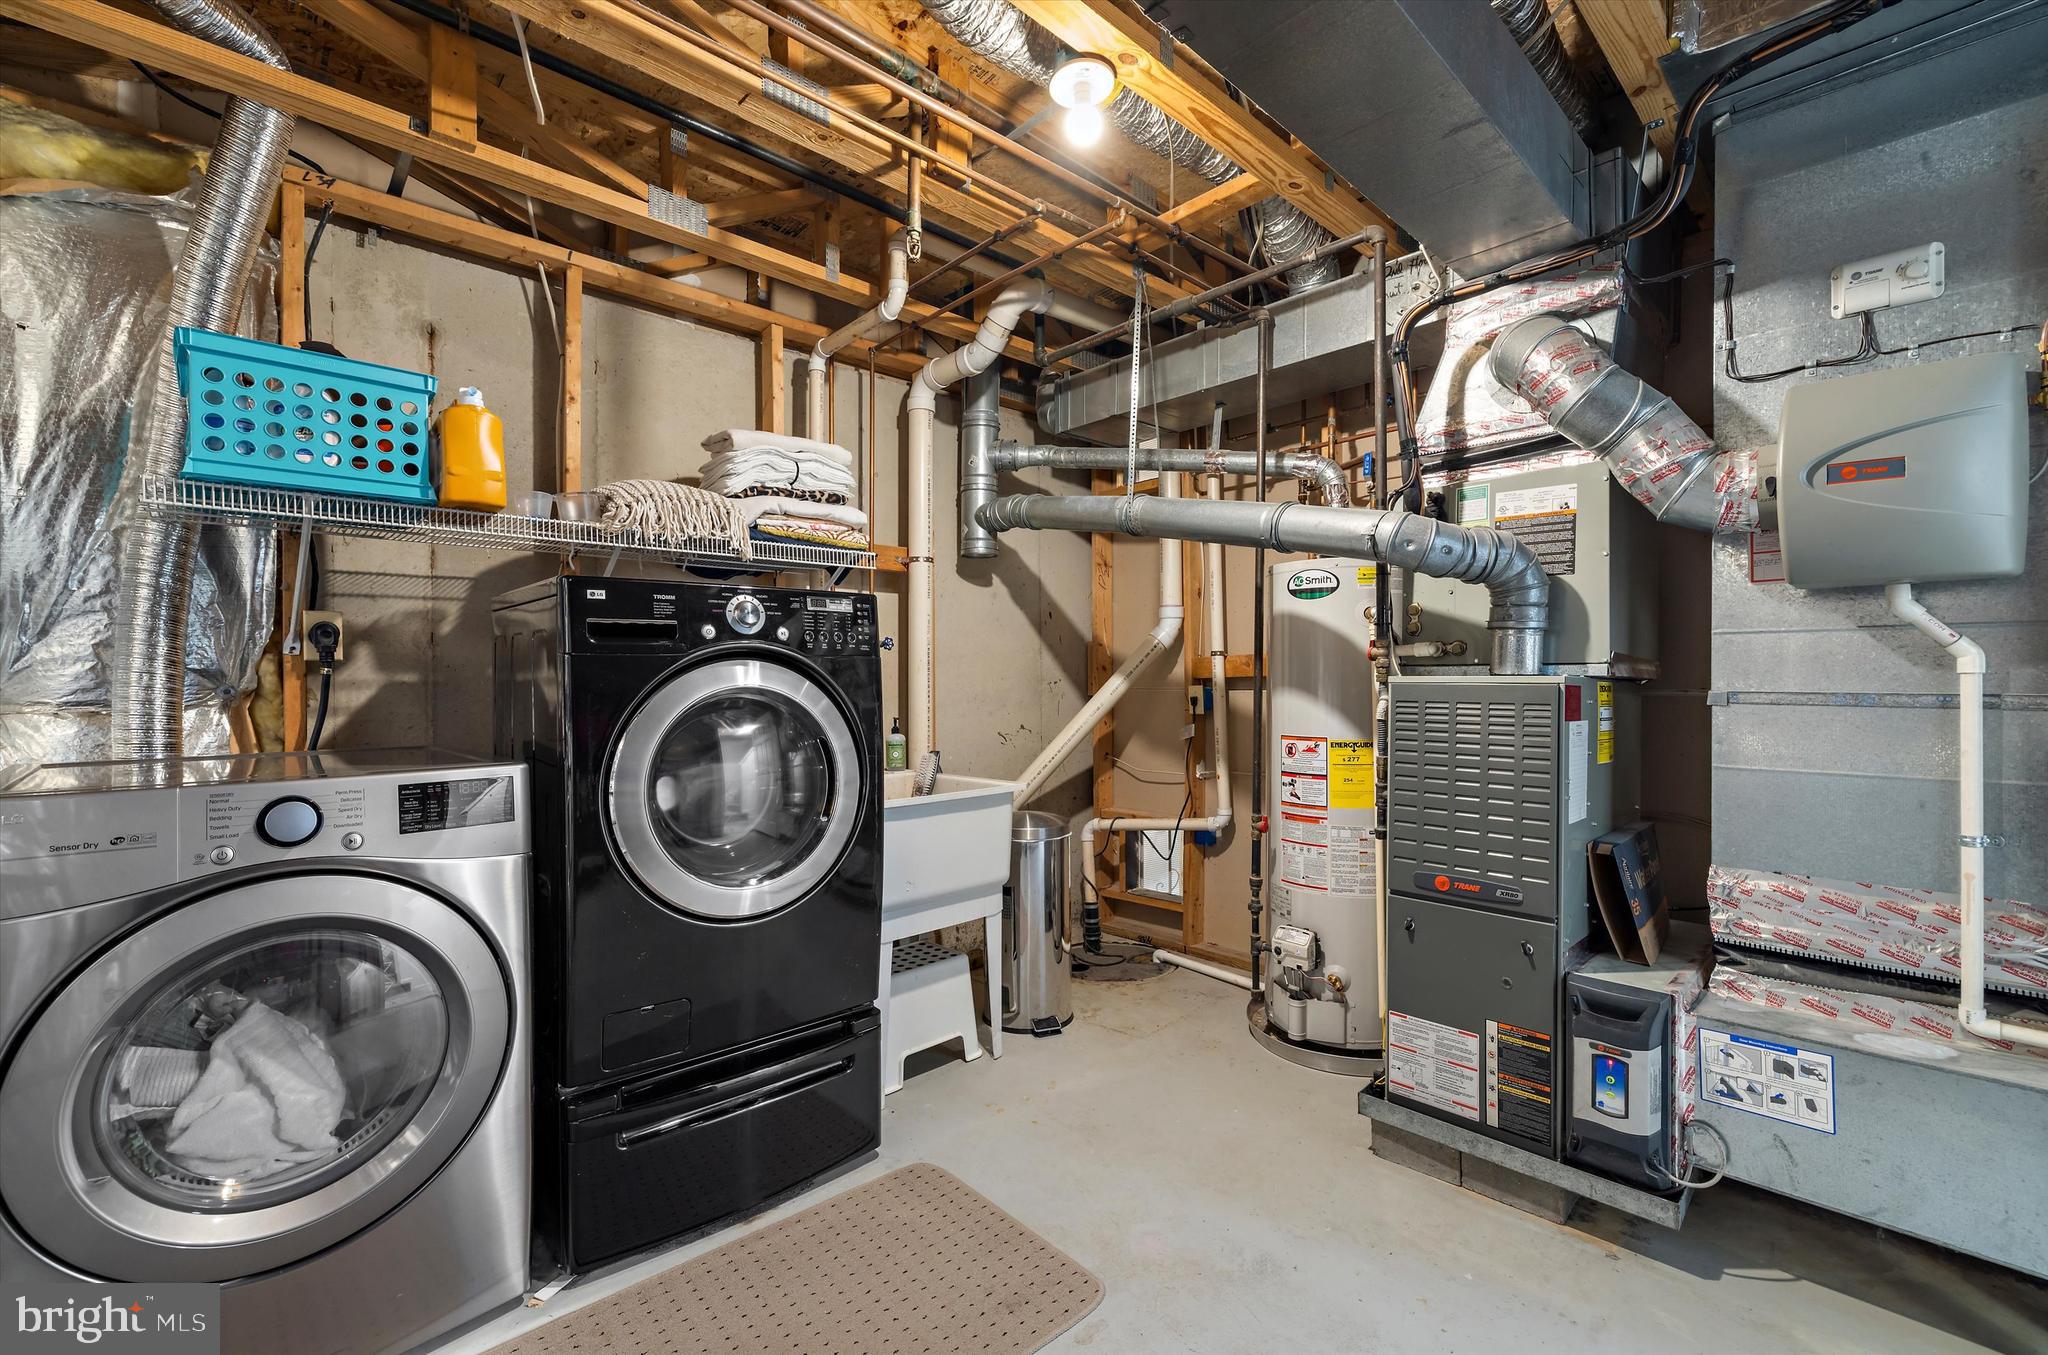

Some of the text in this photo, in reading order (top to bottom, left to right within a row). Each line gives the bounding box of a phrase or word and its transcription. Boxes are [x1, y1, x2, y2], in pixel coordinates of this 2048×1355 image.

[1305, 576, 1332, 585] Smith
[49, 841, 99, 853] Sensor Dry
[1453, 882, 1481, 892] TRANE
[1500, 891, 1519, 899] XR80
[1631, 898, 1642, 917] 35
[1851, 1008, 1891, 1030] VentureTape
[1910, 1016, 1952, 1039] VentureTape
